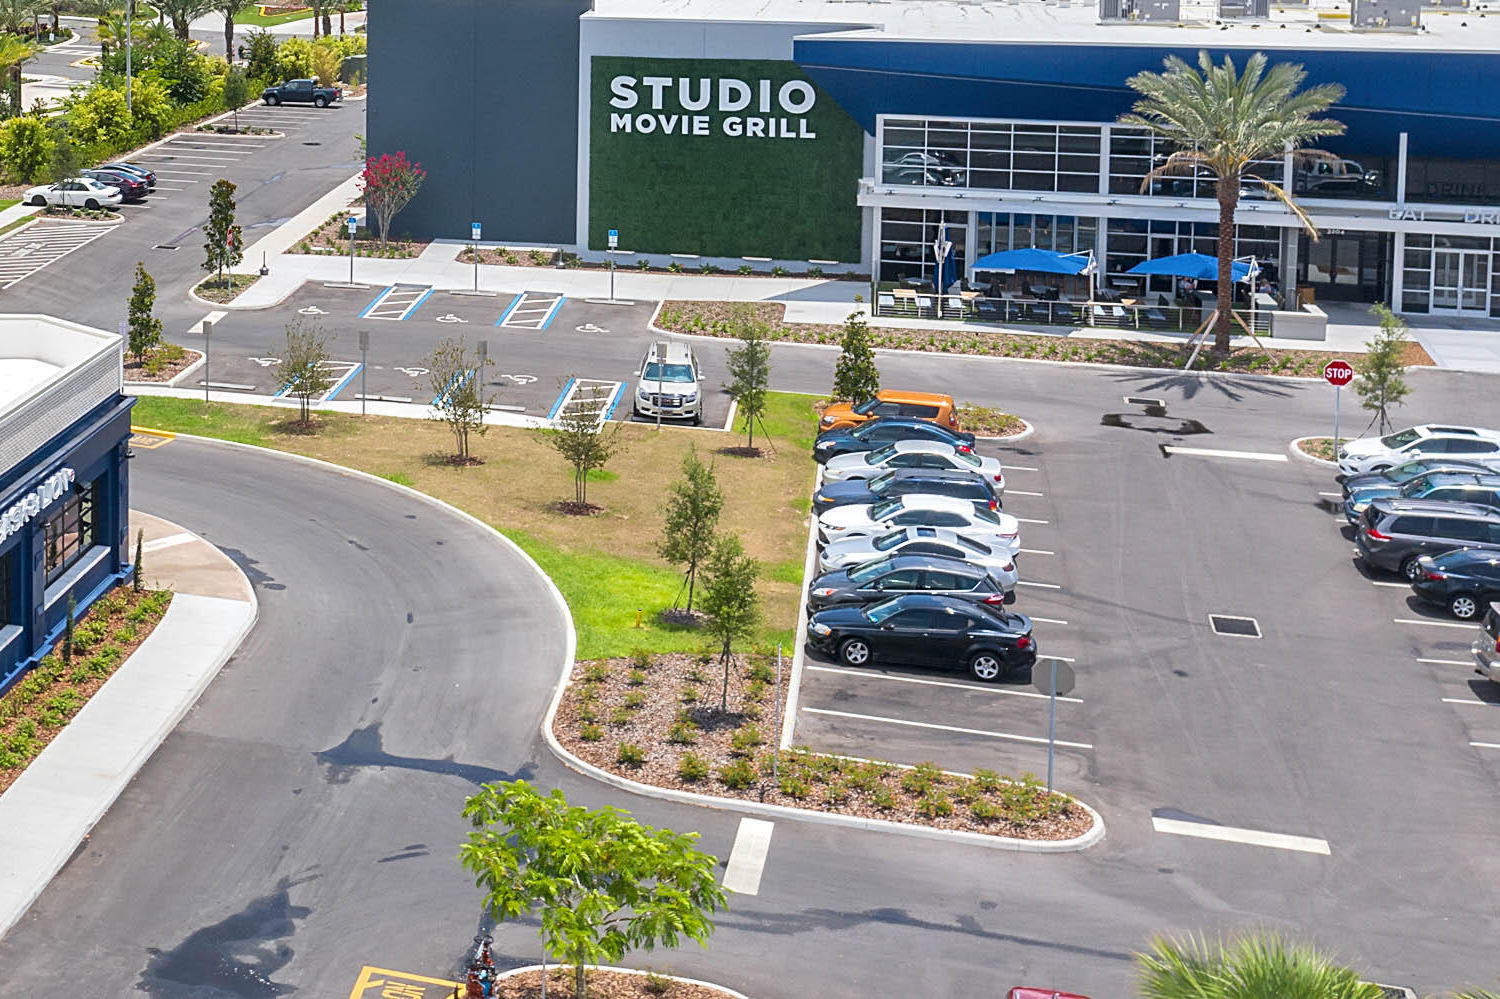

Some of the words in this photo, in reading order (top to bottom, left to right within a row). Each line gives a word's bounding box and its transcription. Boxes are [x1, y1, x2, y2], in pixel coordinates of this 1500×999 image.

[609, 76, 816, 114] STUDIO
[610, 113, 710, 135] MOVIE
[722, 117, 816, 139] GRILL
[1389, 207, 1426, 221] EAT
[1326, 368, 1351, 379] STOP
